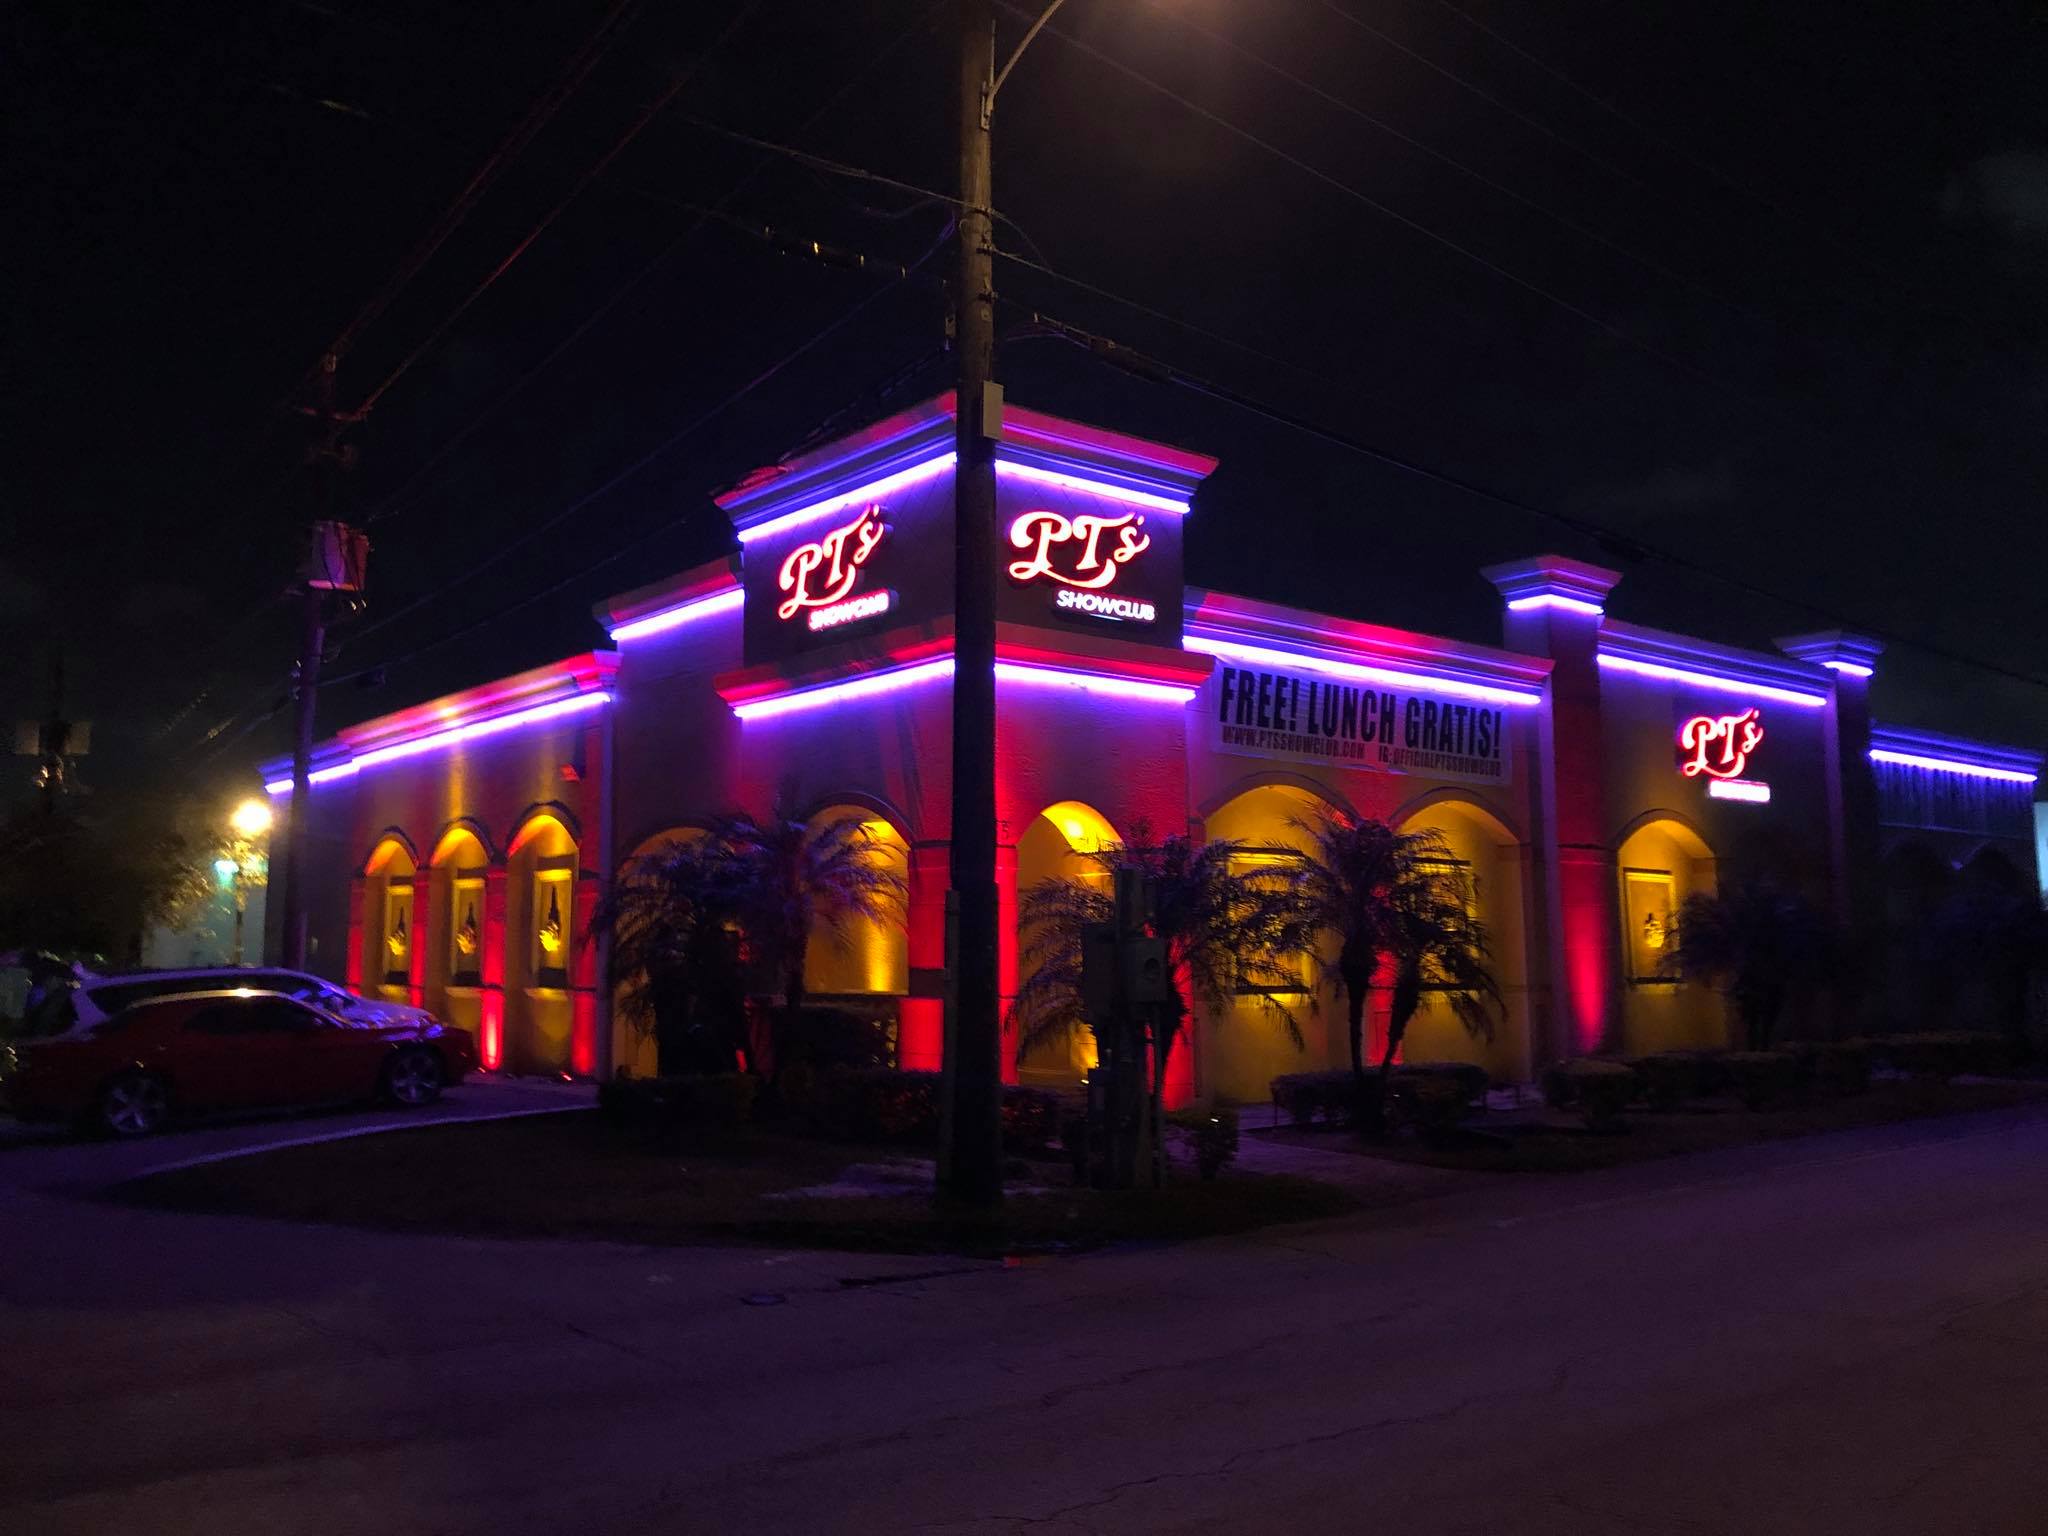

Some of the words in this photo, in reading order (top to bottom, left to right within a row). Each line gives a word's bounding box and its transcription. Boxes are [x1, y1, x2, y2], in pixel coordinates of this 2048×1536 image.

[1056, 589, 1156, 621] SHOWCLUB
[1219, 667, 1300, 732] FREE!
[1308, 681, 1397, 745] LUNCH
[1404, 696, 1502, 759] GRATIS!
